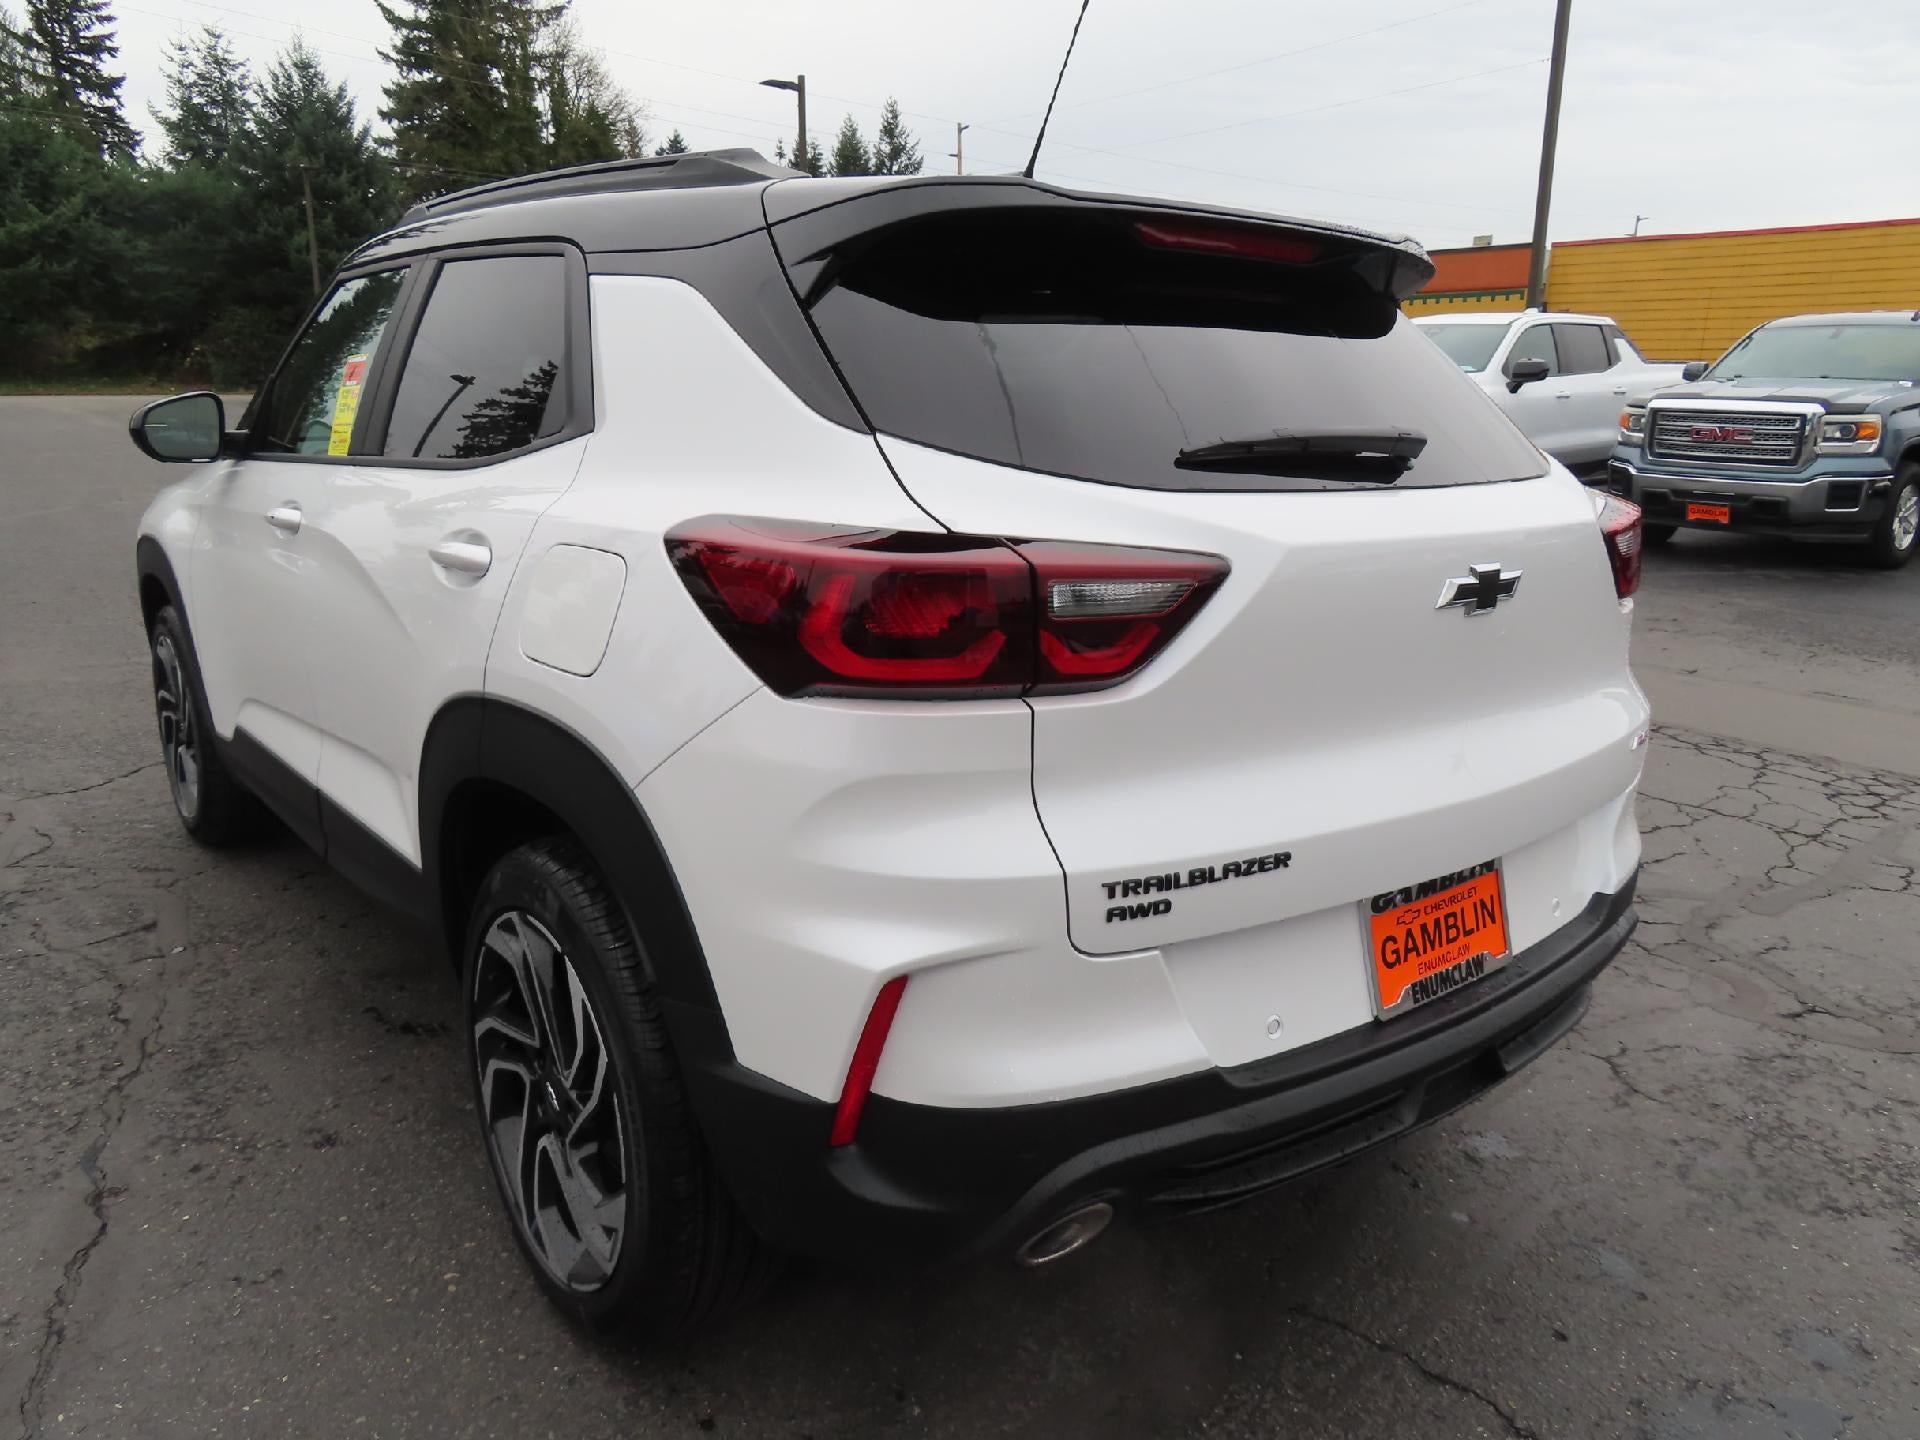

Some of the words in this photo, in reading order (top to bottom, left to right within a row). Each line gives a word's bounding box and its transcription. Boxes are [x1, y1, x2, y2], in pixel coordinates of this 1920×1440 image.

[1690, 426, 1754, 444] GMC
[1101, 851, 1292, 900] TRAILBLAZER
[1105, 898, 1172, 923] AWD
[1424, 886, 1479, 916] CHEVROLET
[1381, 894, 1497, 970] GAMBLIN
[1418, 943, 1471, 976] ENUMCLAW
[1410, 953, 1485, 1005] ENUMCLAW
